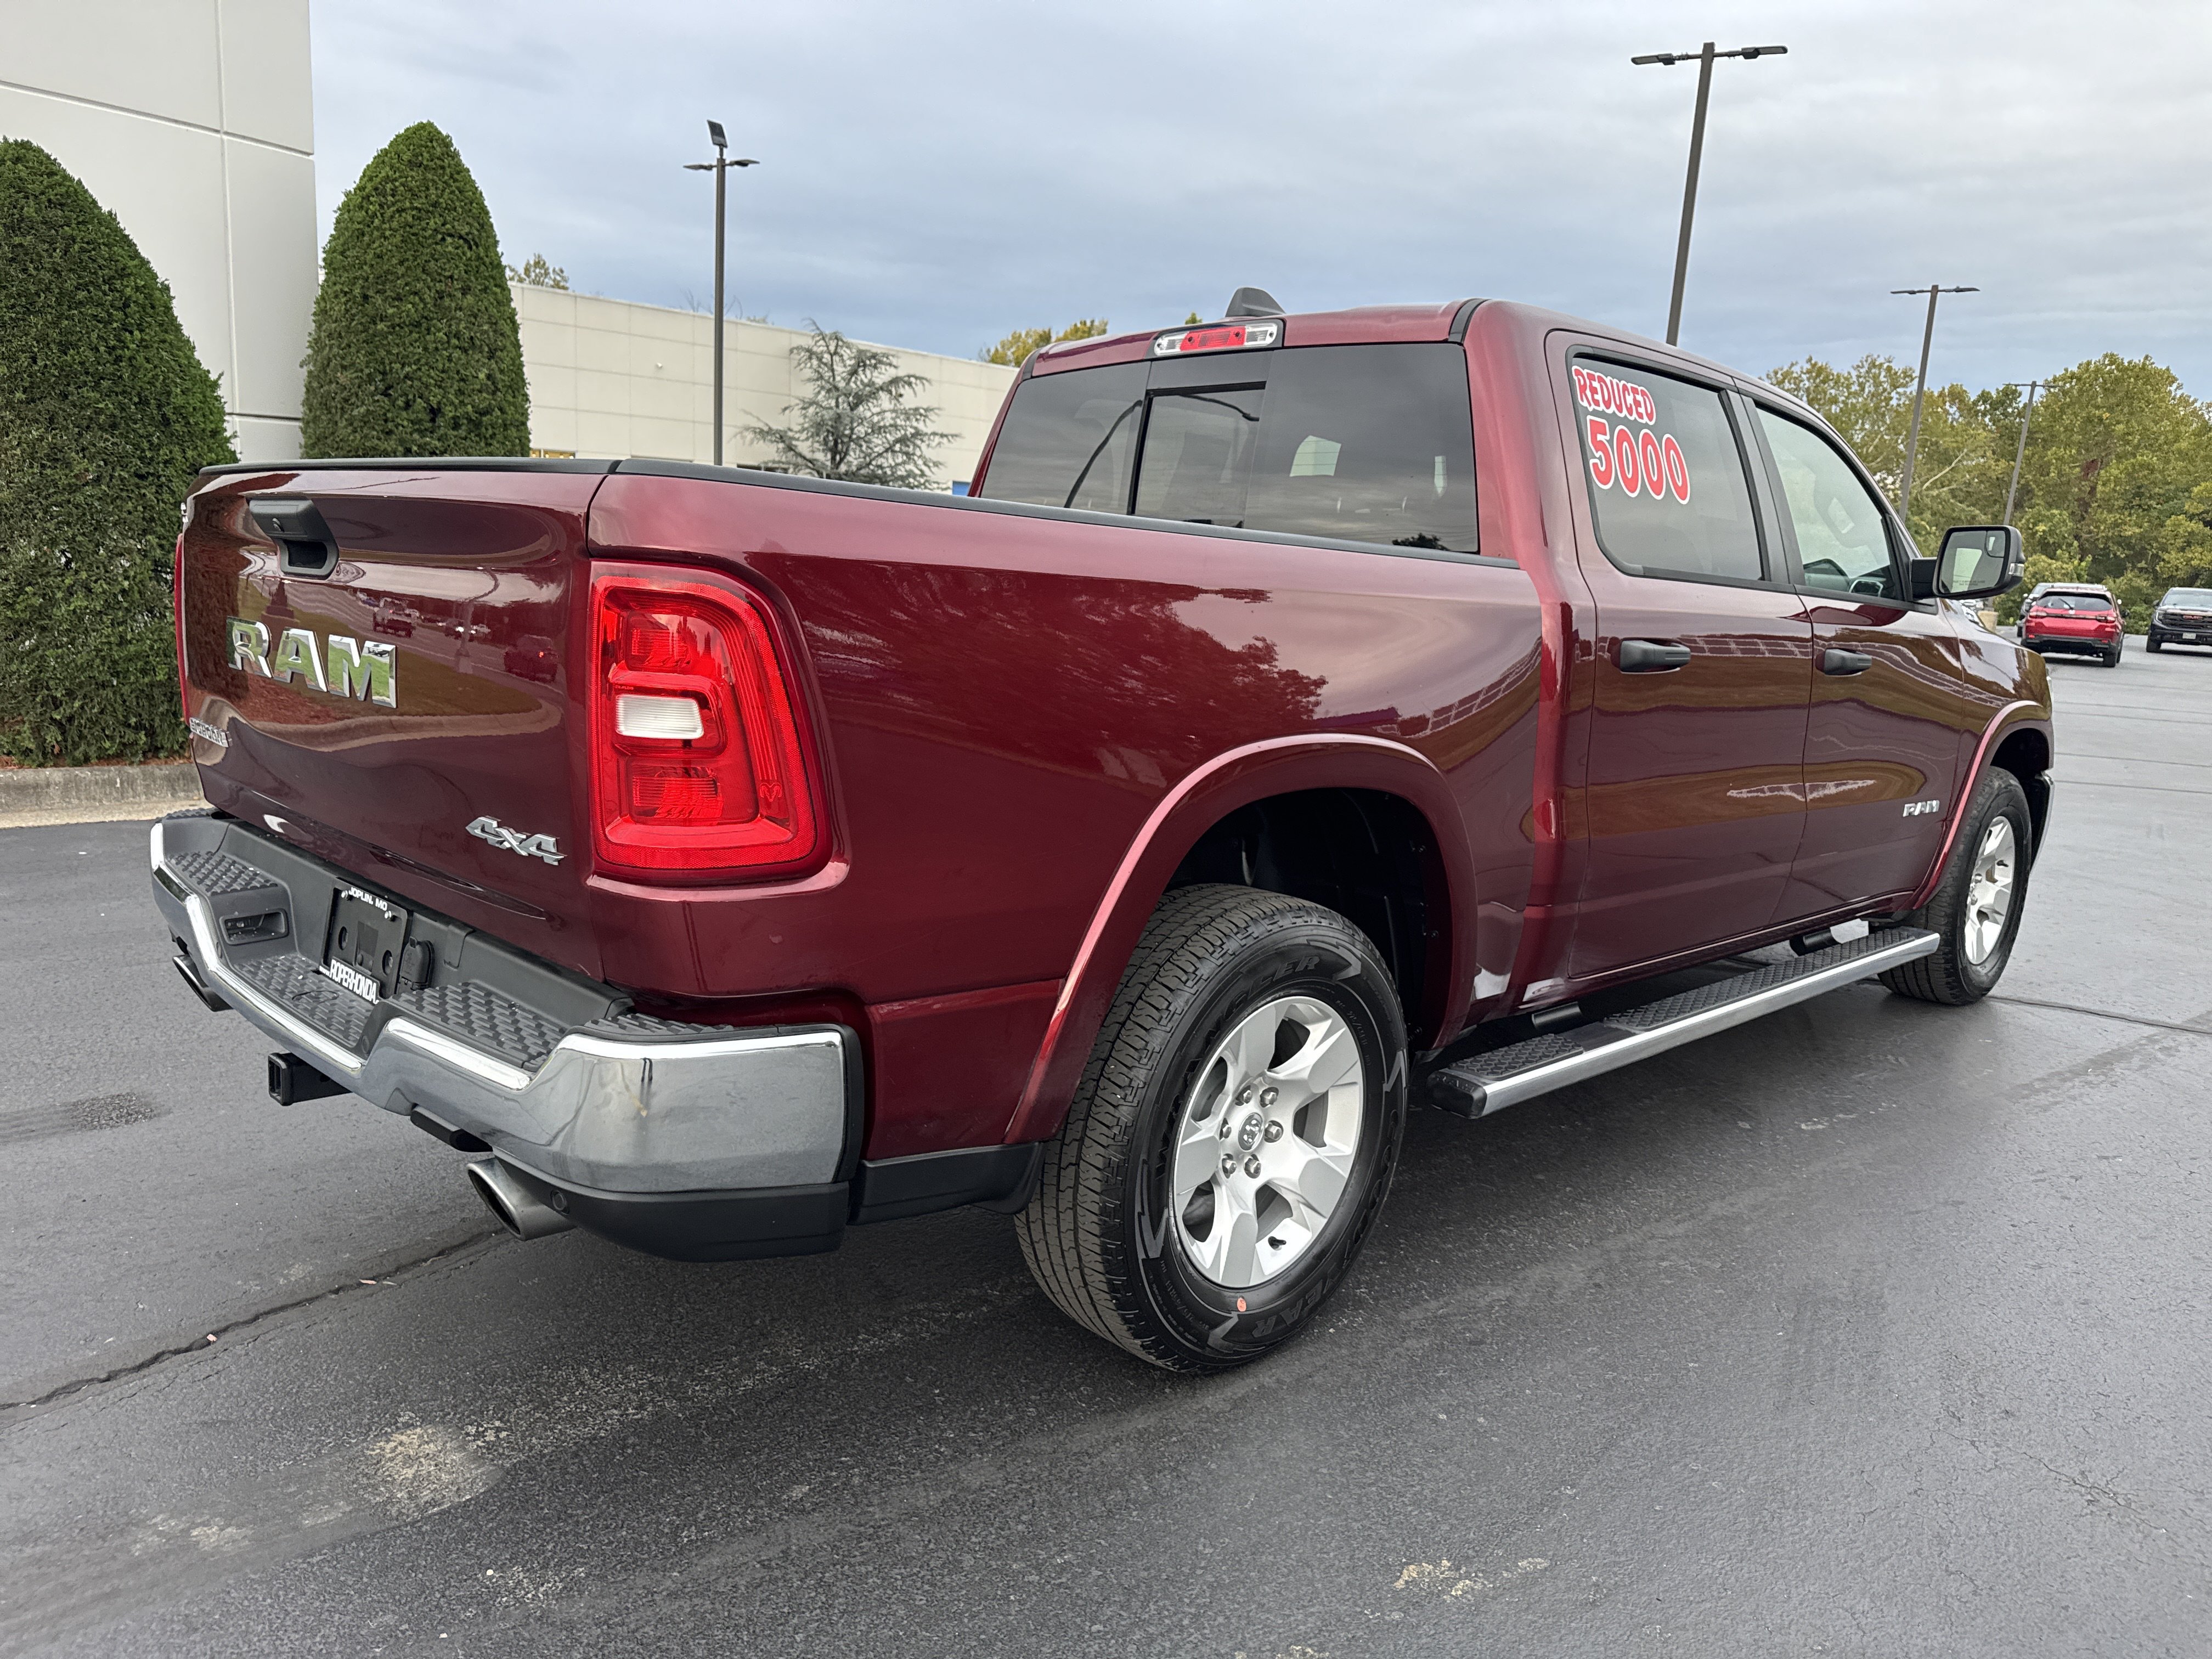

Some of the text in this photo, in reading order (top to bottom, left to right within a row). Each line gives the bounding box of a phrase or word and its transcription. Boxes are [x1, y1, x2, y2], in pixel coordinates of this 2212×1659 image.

[1572, 365, 1656, 425] REDUCED
[1587, 415, 1690, 505] 5000
[226, 616, 397, 709] RAM
[1903, 799, 1940, 817] RAM
[375, 898, 387, 911] MO
